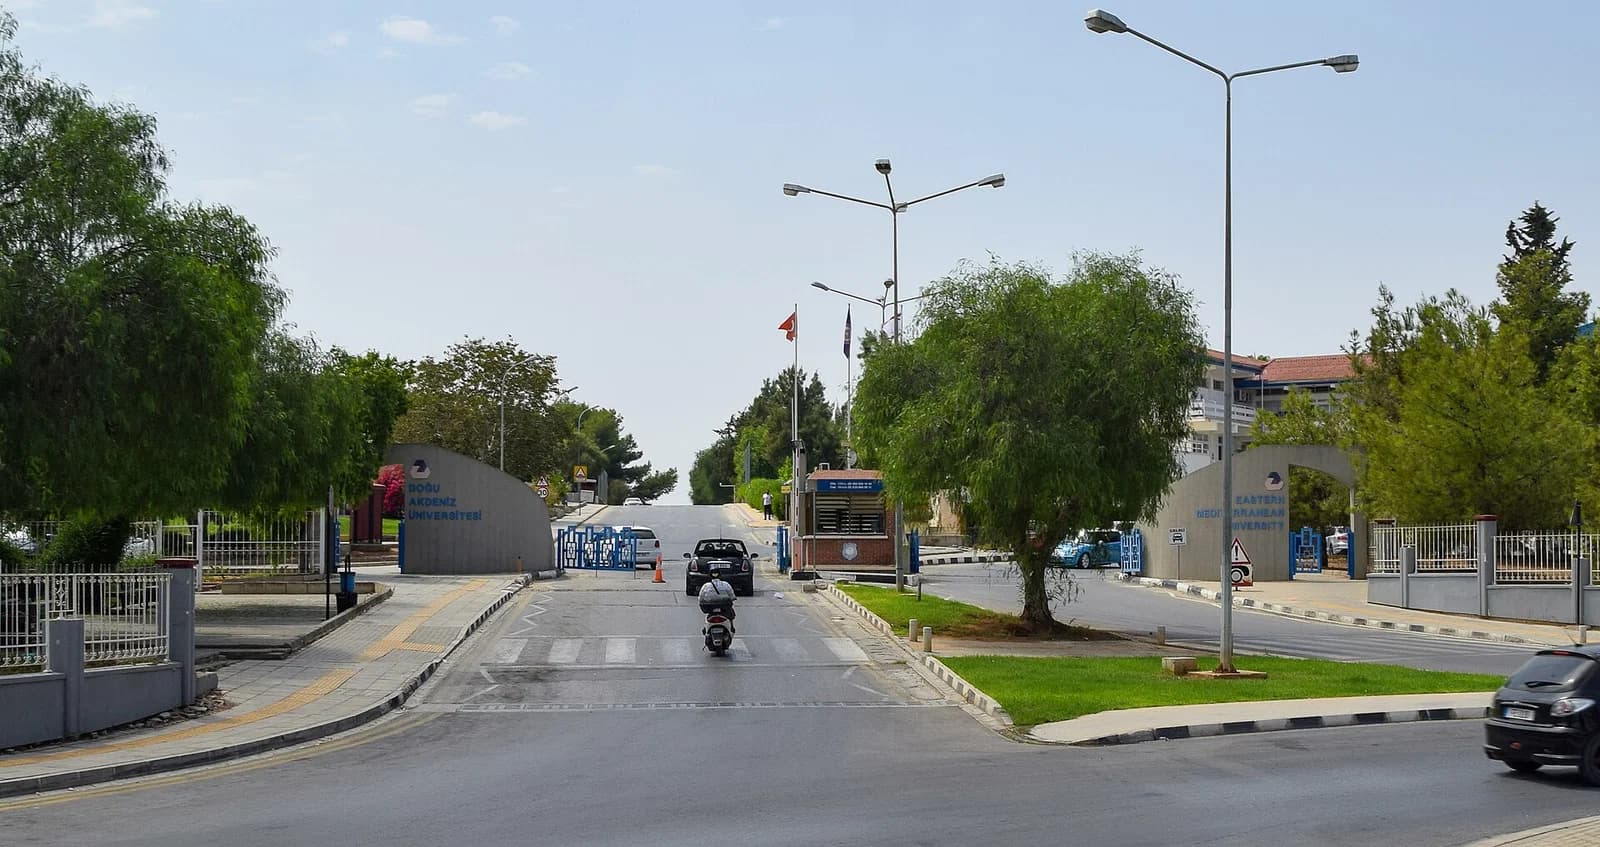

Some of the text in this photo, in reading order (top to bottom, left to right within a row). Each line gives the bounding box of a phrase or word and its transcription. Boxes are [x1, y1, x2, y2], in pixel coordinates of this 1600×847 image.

[409, 495, 457, 507] AKDENİZ
[1235, 495, 1286, 505] EASTERN
[408, 509, 482, 521] ÜNİVERSİTESİ
[1196, 508, 1285, 519] MEDIRRANEAN
[1232, 521, 1285, 531] NIVERSITY
